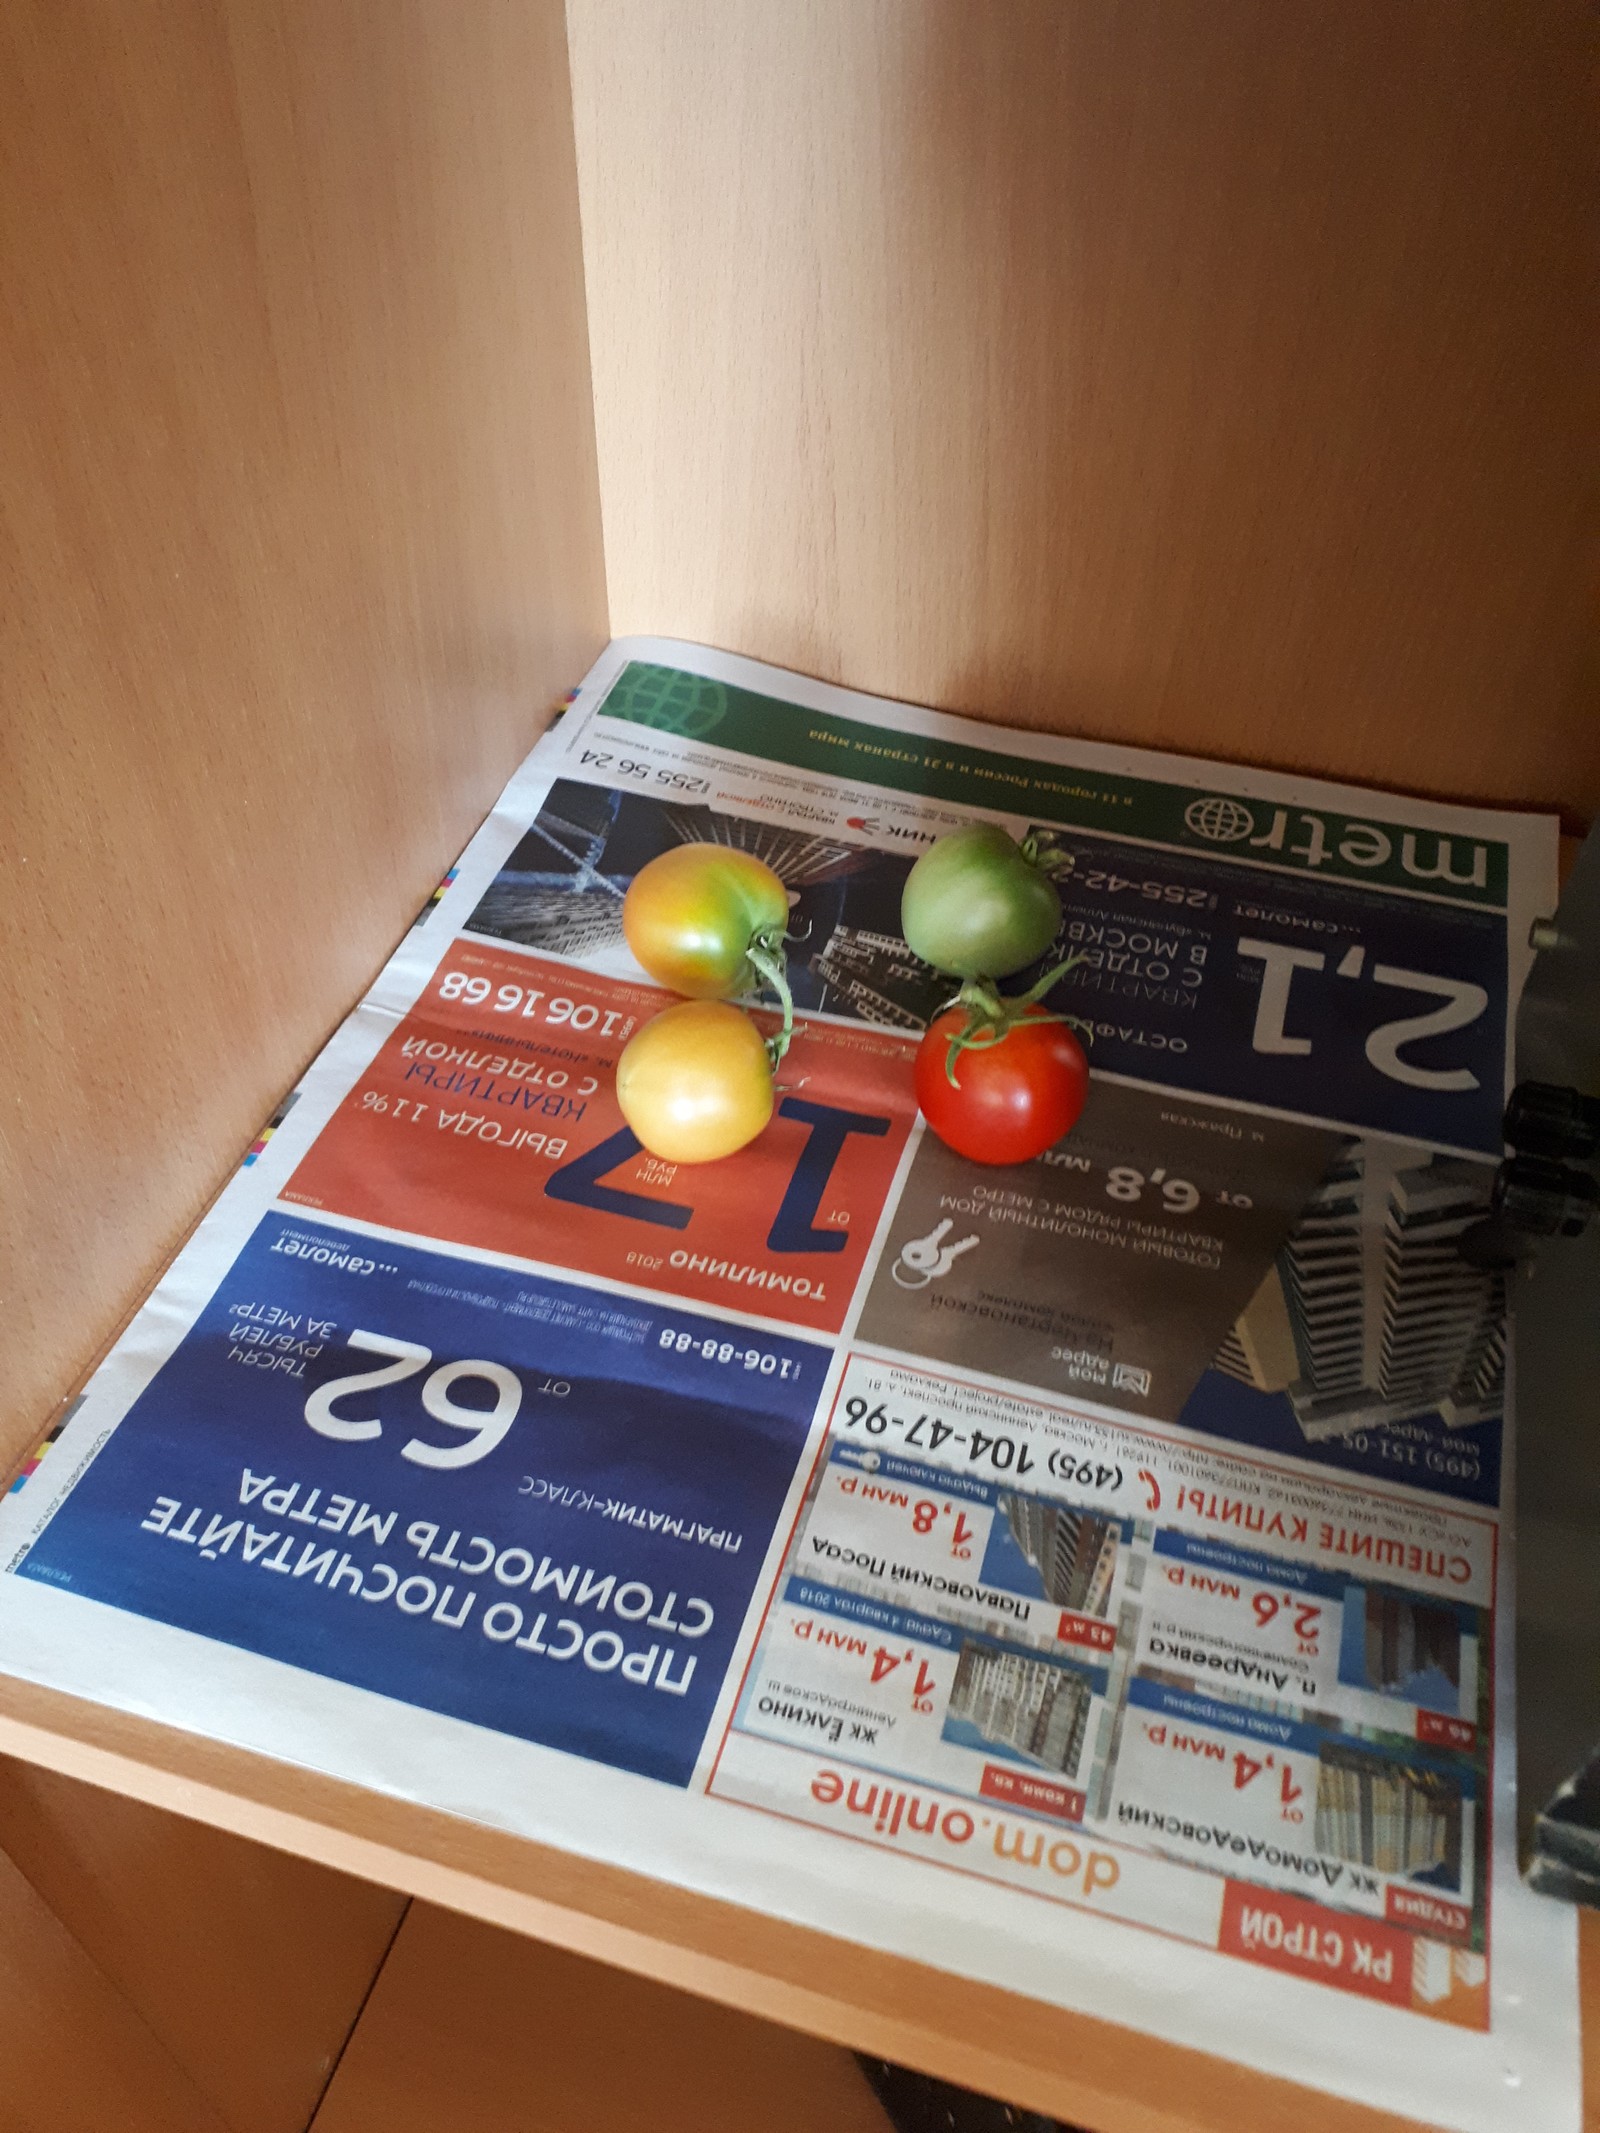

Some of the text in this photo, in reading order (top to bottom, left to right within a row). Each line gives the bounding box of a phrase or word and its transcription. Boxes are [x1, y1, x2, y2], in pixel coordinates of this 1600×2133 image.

[579, 749, 614, 769] 24
[618, 759, 652, 780] 56
[657, 770, 705, 793] 255
[973, 767, 1029, 788] России
[1048, 857, 1208, 908] 255-42-2
[1047, 933, 1171, 981] ОТДЕЛК
[1057, 919, 1208, 966] В МОСКВ
[438, 971, 492, 1005] 68
[492, 984, 545, 1018] 16
[1181, 967, 1203, 988] С
[544, 997, 623, 1037] 106
[1236, 936, 1488, 1091] 2,1
[400, 1035, 599, 1097] С ОТДЕЛКОЙ
[403, 1061, 587, 1122] КВАРТИРЫ
[438, 1108, 569, 1160] ВЫГОДА
[635, 1166, 674, 1187] МЛН
[1033, 1145, 1092, 1172] мл
[970, 1185, 1033, 1210] МЕТРО
[1105, 1166, 1200, 1213] 6,8
[826, 1209, 851, 1226] ОТ
[939, 1194, 1221, 1270] ГОТОВЫЙ МОНОЛИТНЫЙ ДОМ
[1052, 1202, 1121, 1229] РЯДОМ
[1126, 1219, 1224, 1255] КВАРТИРЫ
[669, 1249, 826, 1301] ТОМИЛИНО
[228, 1321, 325, 1364] РУБЛЕЙ
[307, 1316, 338, 1339] ЗА
[227, 1340, 307, 1378] ТЫСЯЧ
[658, 1328, 793, 1379] 106-88-88
[1050, 1346, 1110, 1373] адрес
[303, 1328, 523, 1470] 62
[537, 1378, 571, 1398] ОТ
[845, 1396, 1035, 1475] 104-47-96
[1047, 1449, 1124, 1492] (495)
[1424, 1447, 1481, 1481] (495)
[518, 1475, 743, 1553] ПРАГМАТИК-КЛАСС
[836, 1476, 973, 1550] 1,8 млн р.
[1177, 1489, 1309, 1544] КУПИТЬ!
[238, 1467, 715, 1638] СТОИМОСТЬ МЕТРА
[1319, 1523, 1472, 1585] СПЕШИТЕ
[140, 1496, 698, 1696] ПРОСТО ПОСЧИТАЙТЕ
[799, 1586, 831, 1607] 2018
[812, 1536, 1031, 1622] Павловский Посад
[1162, 1565, 1322, 1641] 2,6 млн р.
[790, 1619, 936, 1701] 1,4 млн р.
[1148, 1637, 1316, 1696] п. Андреевка
[757, 1696, 844, 1743] Ёлкино
[1142, 1723, 1303, 1805] 1,4 млн р.
[810, 1770, 1121, 1896] dom.online
[1117, 1801, 1344, 1888] Домодедовский
[1239, 1905, 1394, 1983] РК СТРОЙ
